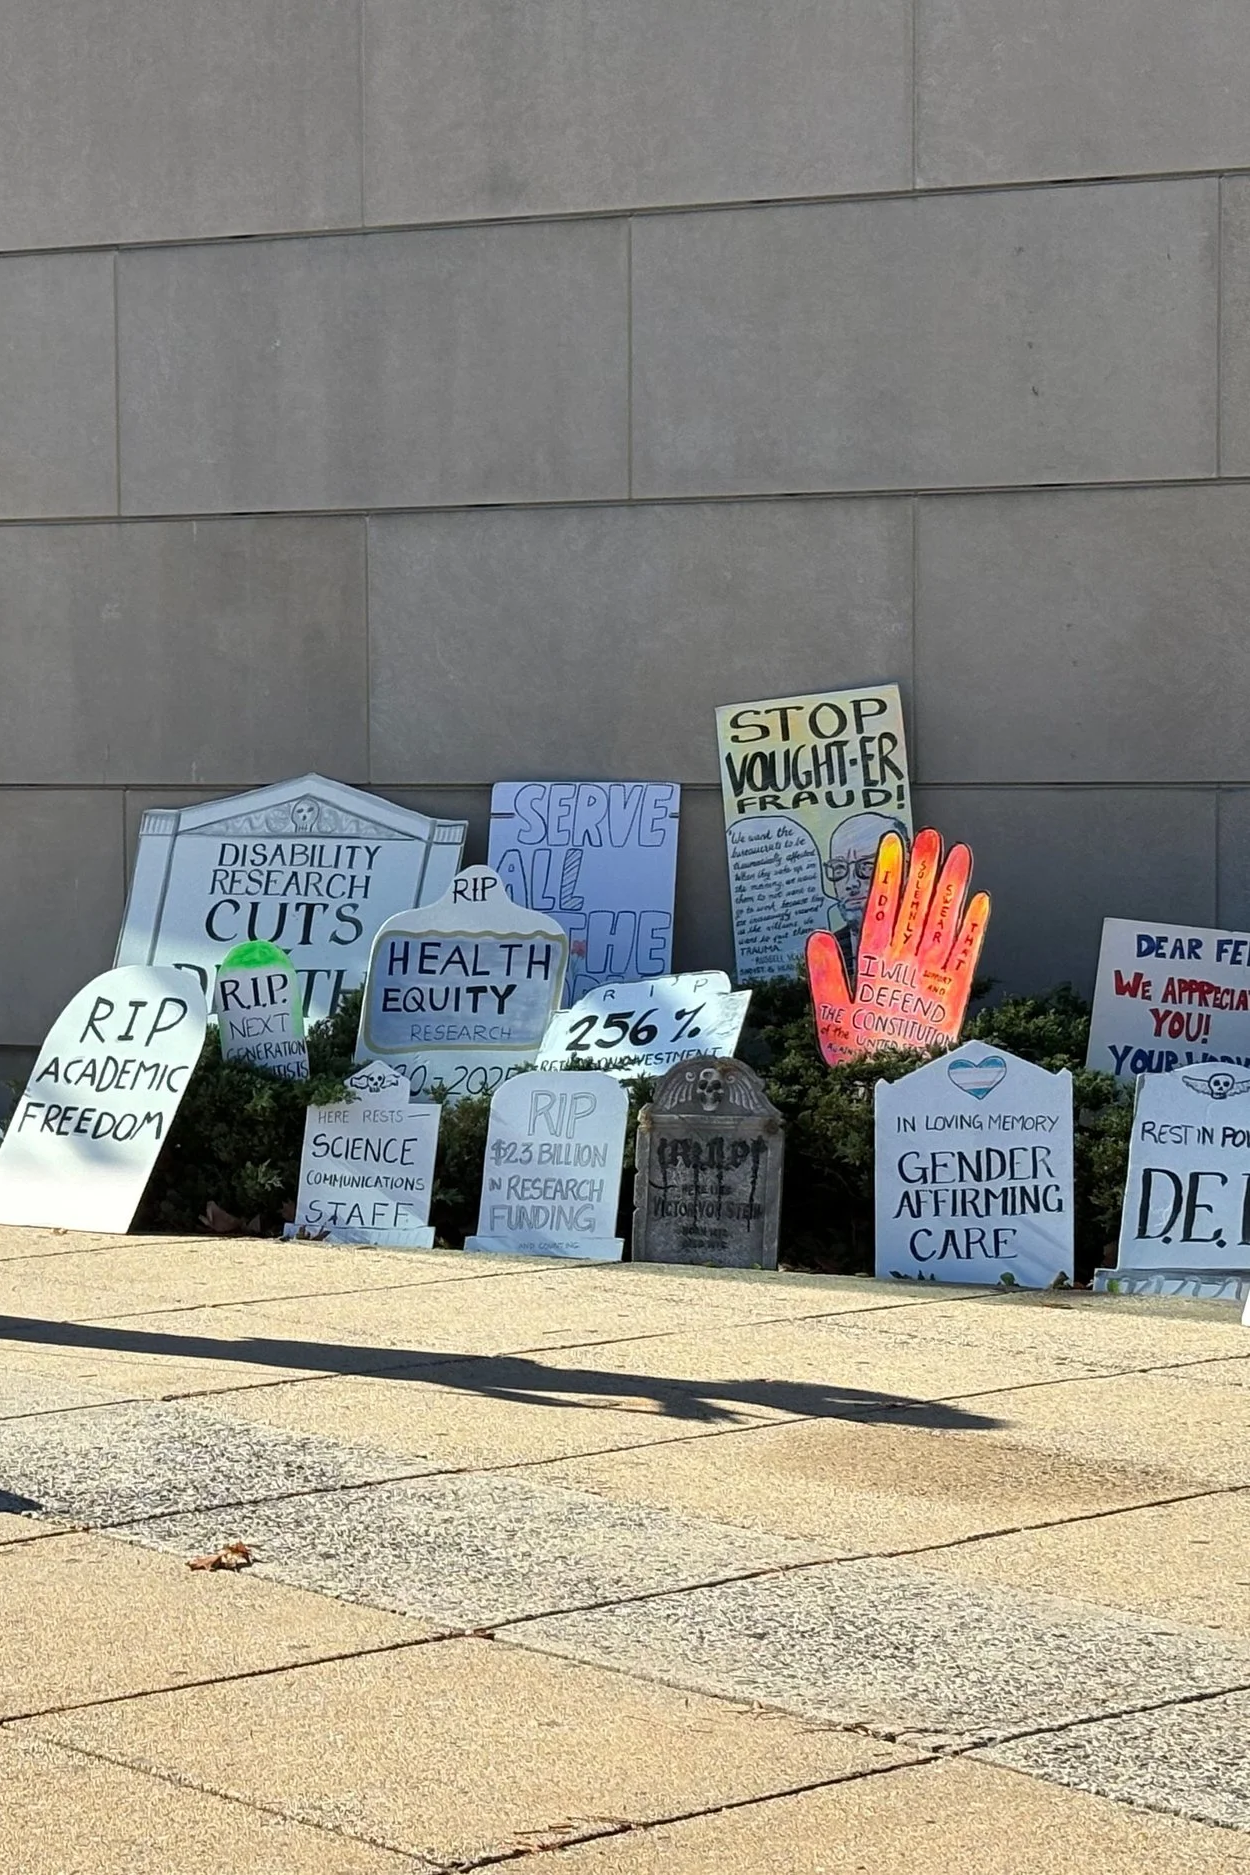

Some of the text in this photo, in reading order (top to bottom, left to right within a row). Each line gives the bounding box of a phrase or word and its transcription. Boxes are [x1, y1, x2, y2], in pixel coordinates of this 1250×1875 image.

[729, 697, 888, 744] STOP
[725, 732, 905, 798] VOUGHT-ER
[514, 782, 673, 848] SERVE
[736, 785, 905, 815] FRAUD!
[776, 825, 794, 839] the
[795, 837, 806, 847] be
[217, 843, 382, 870] DISABILITY
[208, 868, 371, 900] RESEARCH
[452, 876, 498, 905] RIP
[496, 847, 584, 912] ALL
[881, 870, 891, 885] I
[205, 898, 364, 946] CUTS
[932, 884, 954, 944] SWEAR
[544, 910, 671, 976] THE
[955, 922, 978, 971] THAT
[1136, 933, 1203, 961] DEAR
[387, 940, 551, 981] HEALTH
[860, 955, 917, 989] I WILL
[219, 973, 290, 1014] R.I.P.
[381, 984, 517, 1015] EQUITY
[859, 983, 946, 1023] DEFEND
[927, 984, 946, 996] AND
[1114, 969, 1250, 1012] WE APPRECIA
[79, 995, 188, 1047] RIP
[228, 1013, 291, 1041] NEXT
[410, 1023, 512, 1042] RESEARCH
[820, 1005, 954, 1047] THE CONSTITUTION
[820, 1024, 850, 1039] of the
[1149, 1007, 1211, 1045] YOU!
[226, 1039, 307, 1062] GENERATION
[1108, 1044, 1179, 1076] YOUR
[35, 1055, 189, 1093] ACADEMIC
[17, 1101, 164, 1142] FREEDOM
[318, 1109, 404, 1124] HERE RESTS
[527, 1089, 598, 1140] RIP
[897, 1114, 1059, 1134] IN LOVING MEMORY
[312, 1132, 418, 1166] SCIENCE
[1141, 1120, 1195, 1146] REST
[1196, 1126, 1214, 1145] IN
[537, 1143, 608, 1168] BILLION
[897, 1146, 1055, 1185] GENDER
[306, 1169, 425, 1192] COMMUNICATIONS
[488, 1174, 604, 1203] IN RESEARCH
[305, 1199, 414, 1228] STAFF
[489, 1202, 596, 1232] FUNDING
[893, 1184, 1065, 1219] AFFIRMING
[909, 1228, 1018, 1262] CARE
